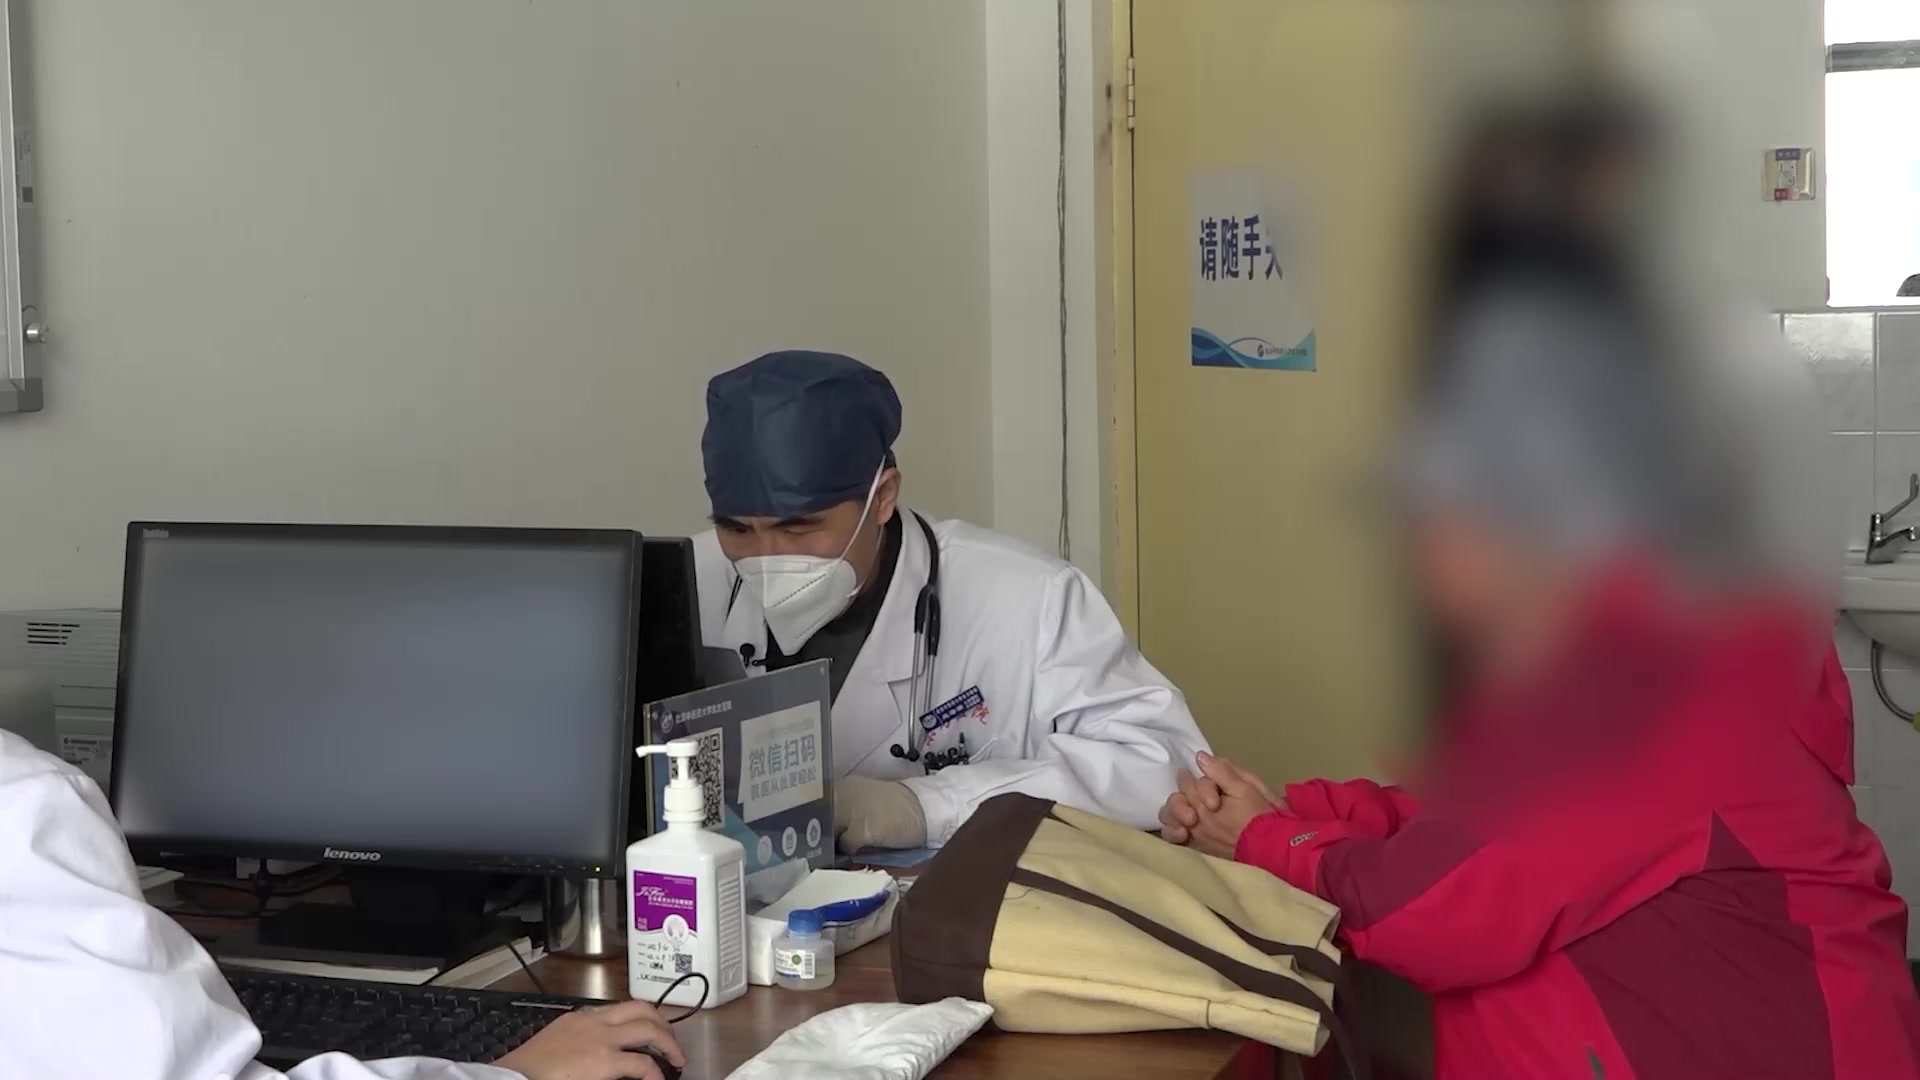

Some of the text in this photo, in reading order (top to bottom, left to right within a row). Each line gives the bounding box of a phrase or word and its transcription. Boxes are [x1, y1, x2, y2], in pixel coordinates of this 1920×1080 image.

[749, 734, 817, 779] 微信扫码
[751, 768, 817, 801] 就医从此更轻松
[323, 846, 382, 861] lenovo
